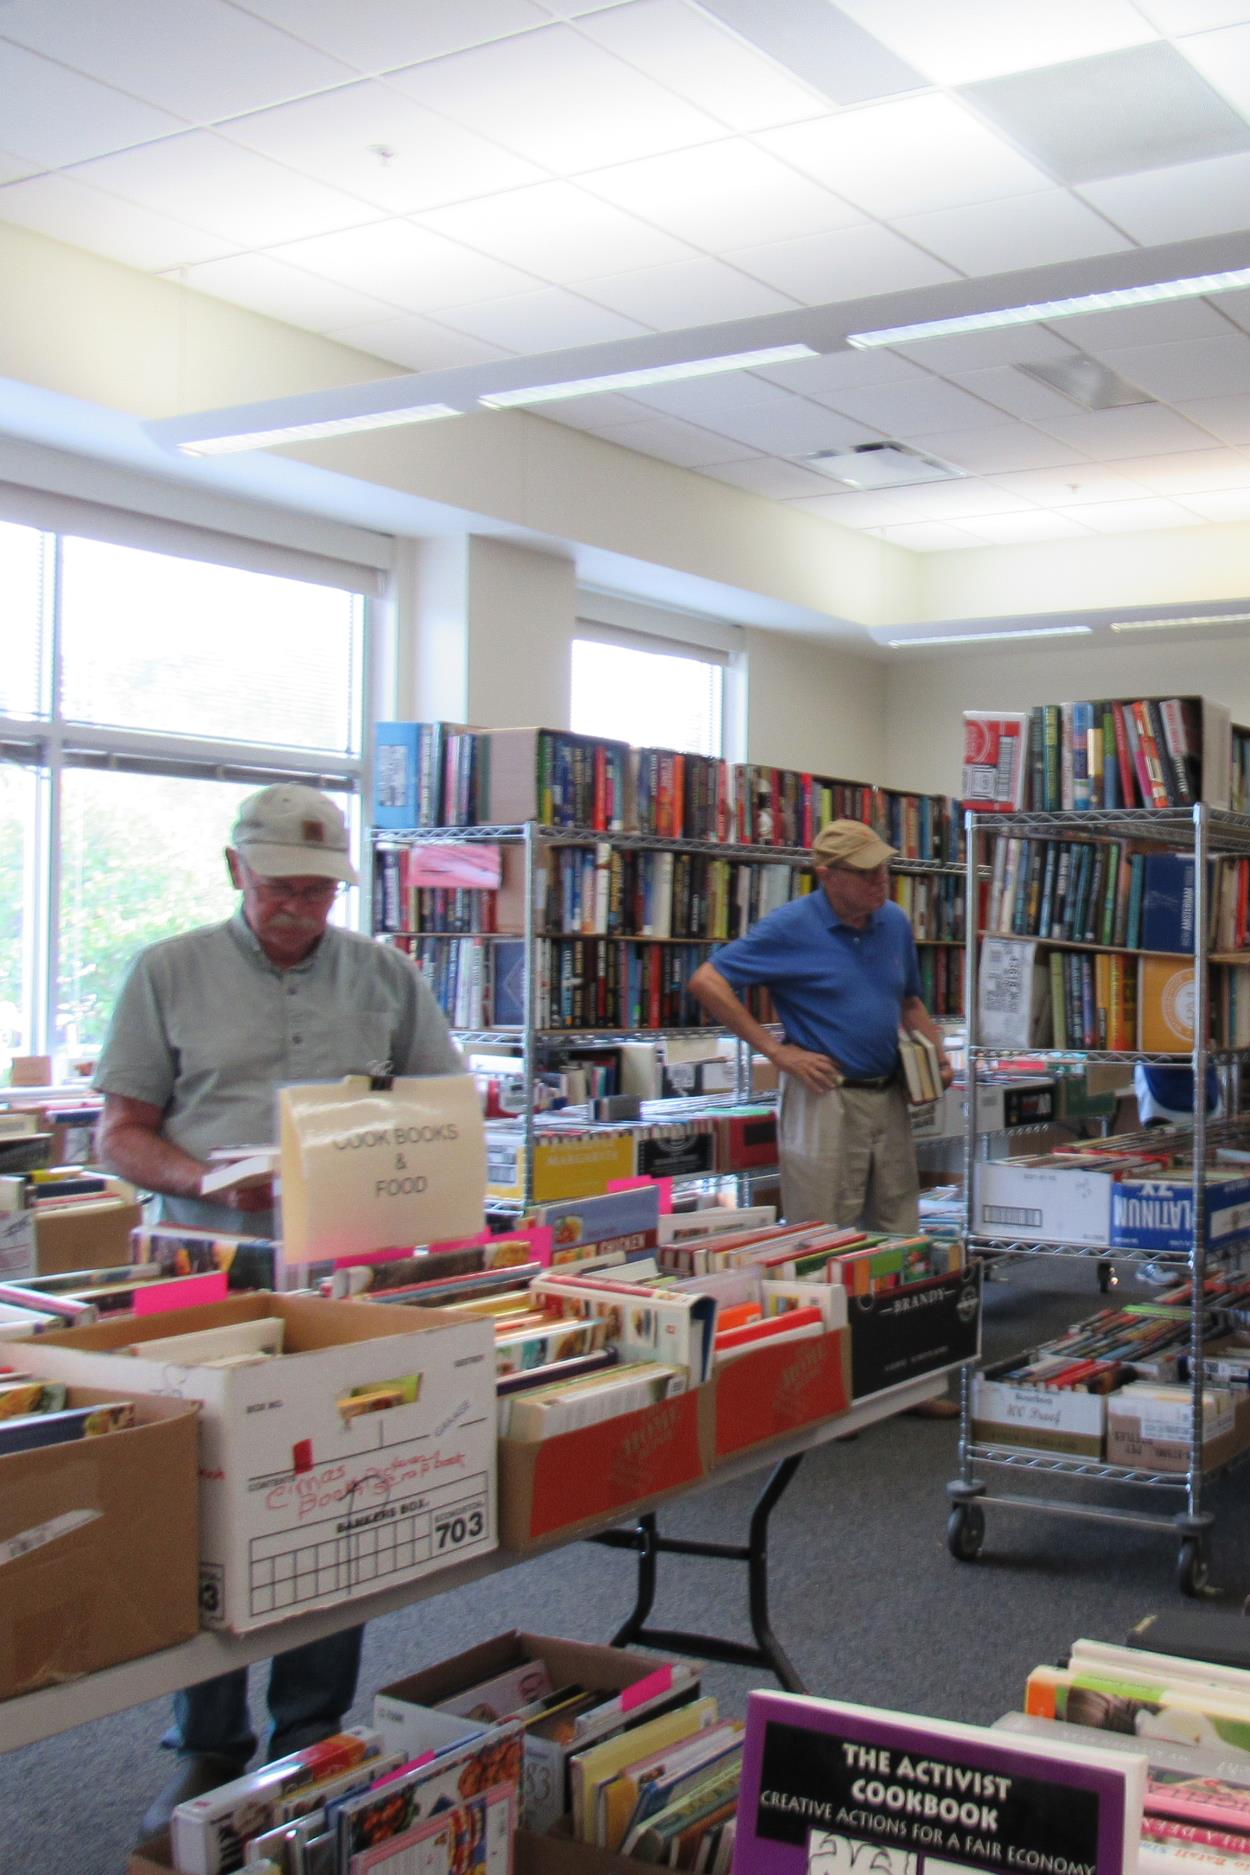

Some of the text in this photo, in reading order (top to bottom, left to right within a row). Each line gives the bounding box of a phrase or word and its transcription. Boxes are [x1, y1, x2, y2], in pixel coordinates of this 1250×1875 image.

[333, 1123, 459, 1151] COOK BOOKS
[394, 1153, 407, 1170] &
[376, 1175, 428, 1198] FOOD
[1113, 1194, 1191, 1230] LATINUM
[336, 1503, 396, 1533] BANKERS
[434, 1510, 485, 1549] 703
[843, 1742, 1012, 1801] THE ACTIVIST
[851, 1778, 999, 1831] COOKBOOK
[760, 1788, 1097, 1875] CREATIVE ACTIONS FOR A FAIR ECONOMY
